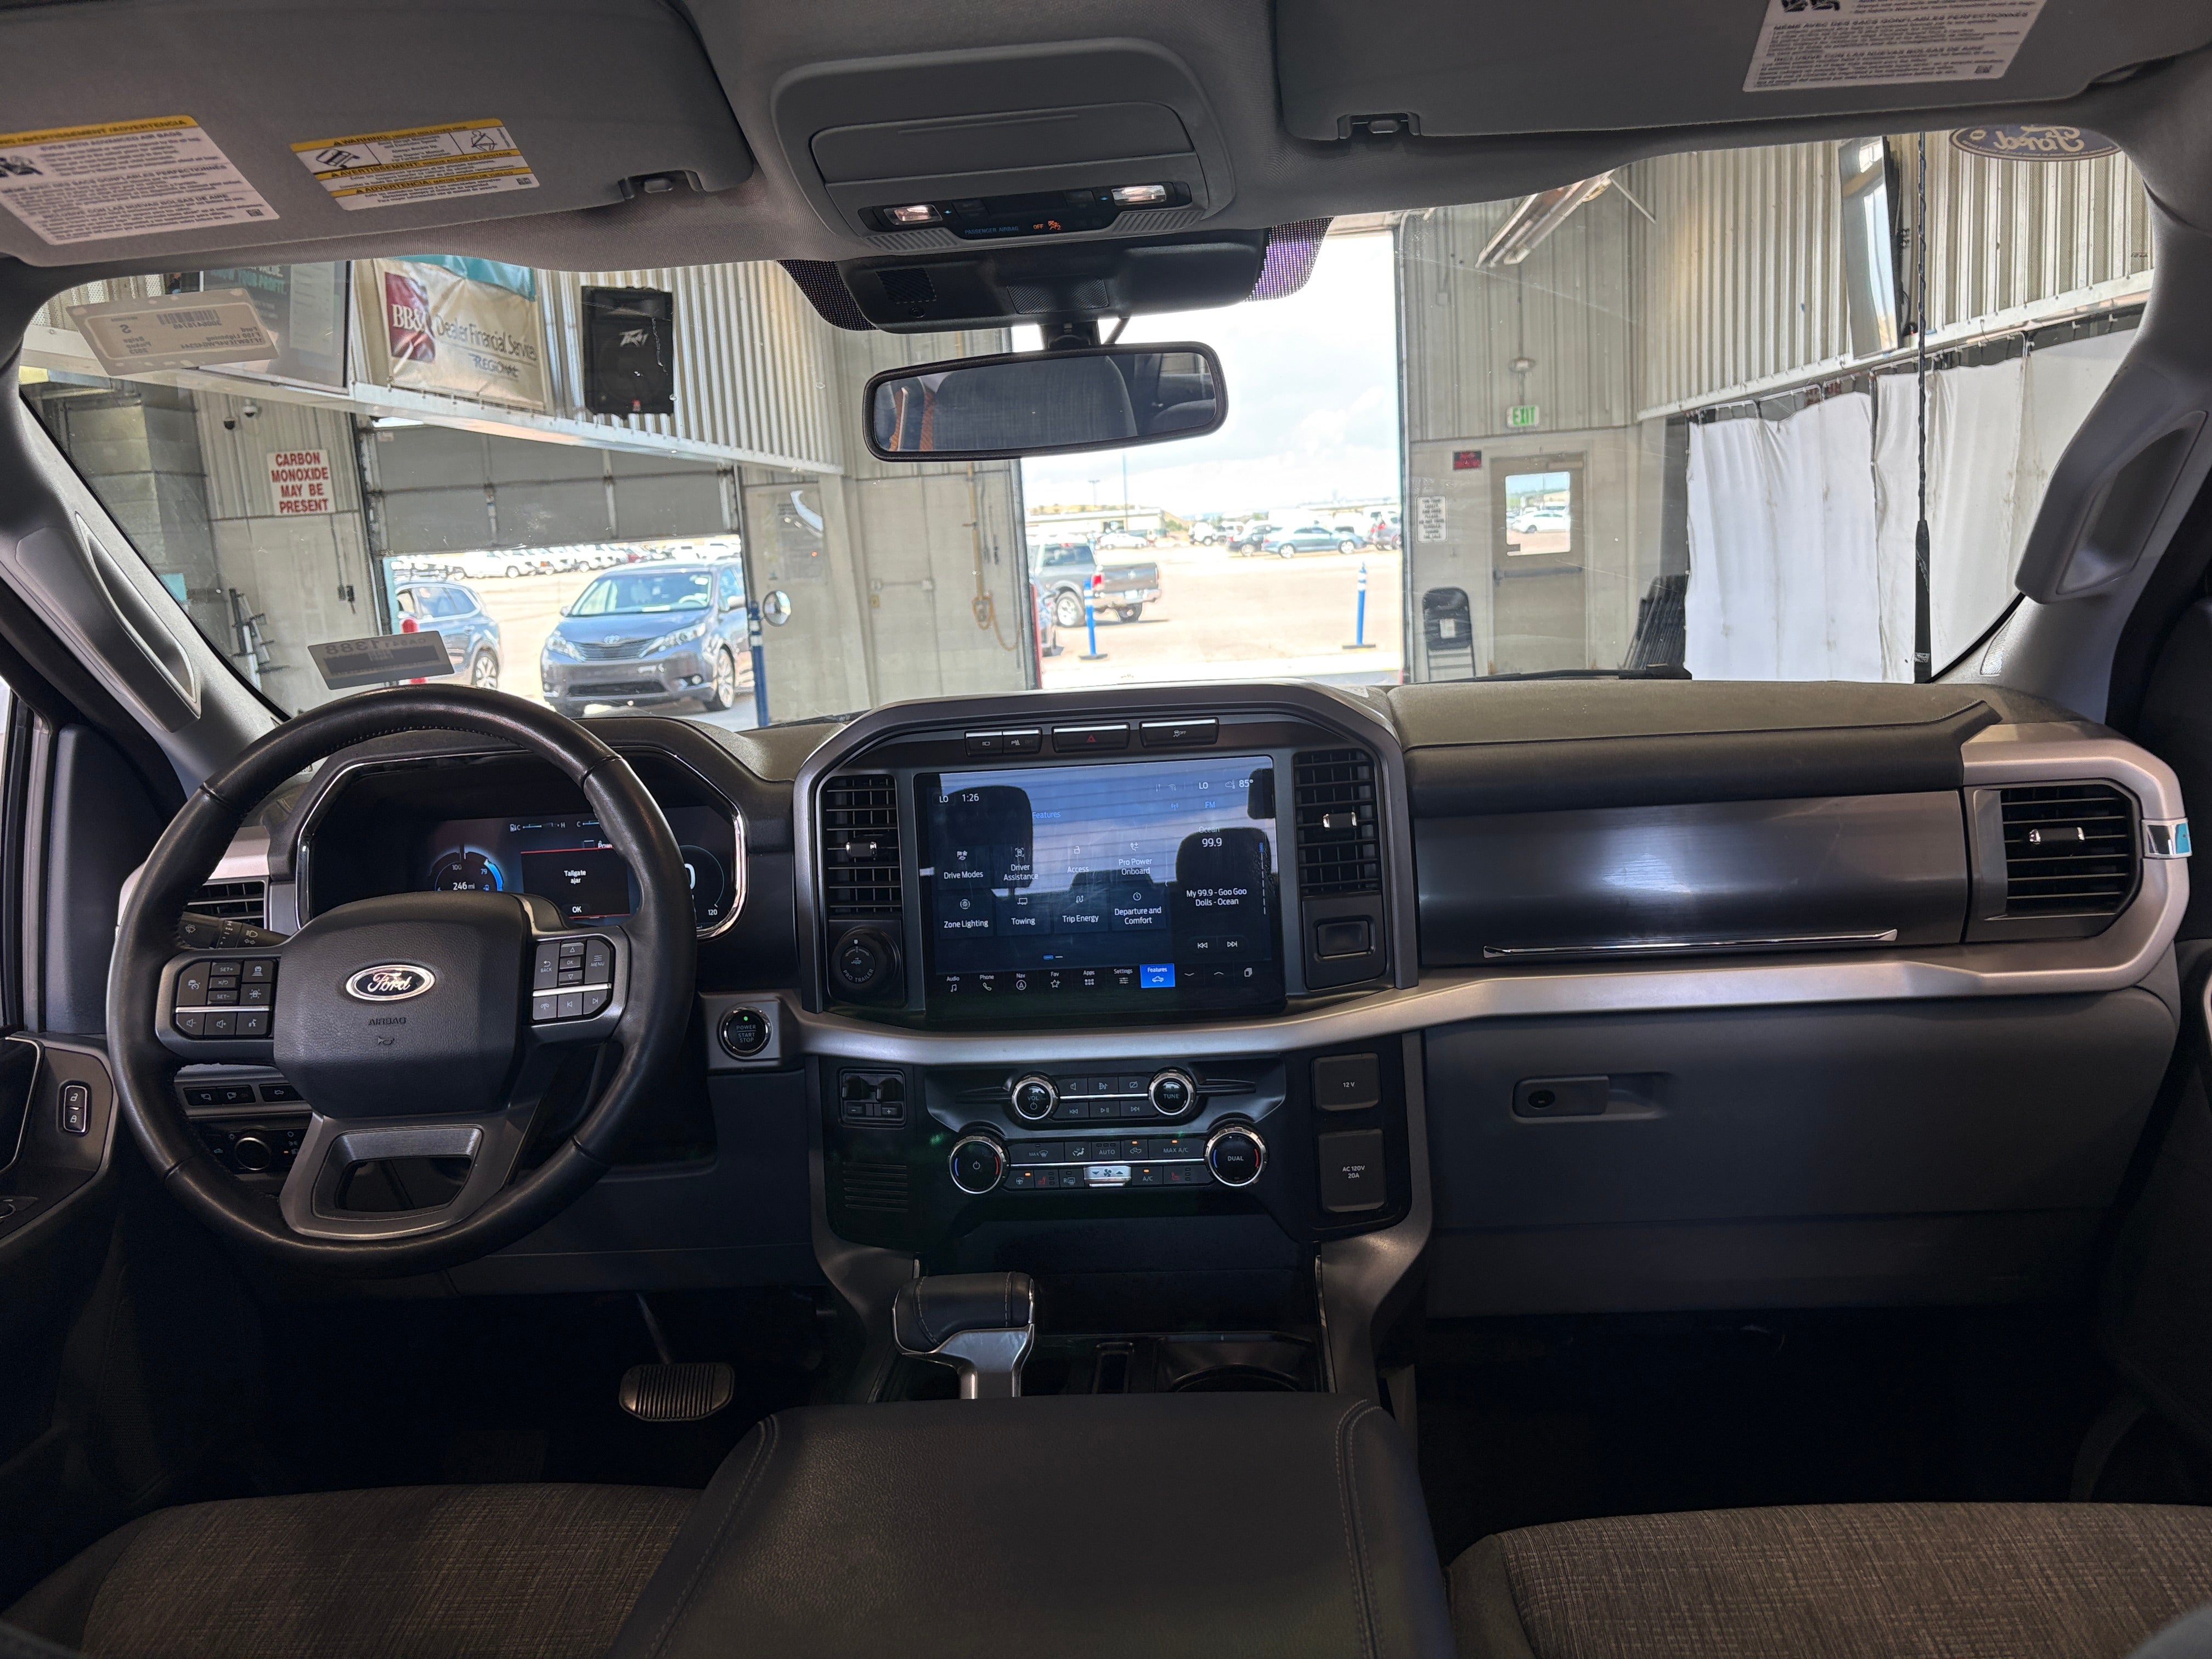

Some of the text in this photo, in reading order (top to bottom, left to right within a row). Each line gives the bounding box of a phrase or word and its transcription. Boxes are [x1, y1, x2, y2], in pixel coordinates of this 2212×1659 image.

[964, 227, 997, 236] PASSENGER
[1513, 407, 1535, 426] EXIT
[275, 453, 320, 466] CARBON
[272, 467, 329, 483] MONOXIDE
[281, 483, 324, 497] MAY BE
[279, 499, 329, 514] PRESENT
[962, 793, 980, 803] 1:26
[1032, 810, 1060, 819] Features
[1201, 838, 1222, 847] 99.9
[1118, 857, 1152, 866] Pro Power
[1011, 863, 1030, 872] Driver
[1066, 865, 1089, 873] Access
[1121, 867, 1150, 876] Onboard
[944, 870, 984, 879] Drive Modes
[1003, 872, 1039, 881] Assistance
[453, 882, 467, 890] 246
[1186, 889, 1196, 899] My
[1218, 888, 1232, 896] Goo
[1195, 898, 1212, 906] Dolls
[1114, 906, 1161, 917] Departure and
[944, 918, 989, 928] Zone Lighting
[1011, 917, 1035, 927] Towing
[1062, 914, 1099, 924] Trip Energy
[1124, 916, 1152, 924] Comfort
[843, 968, 874, 983] PRO TRAILER
[366, 972, 413, 992] Ford
